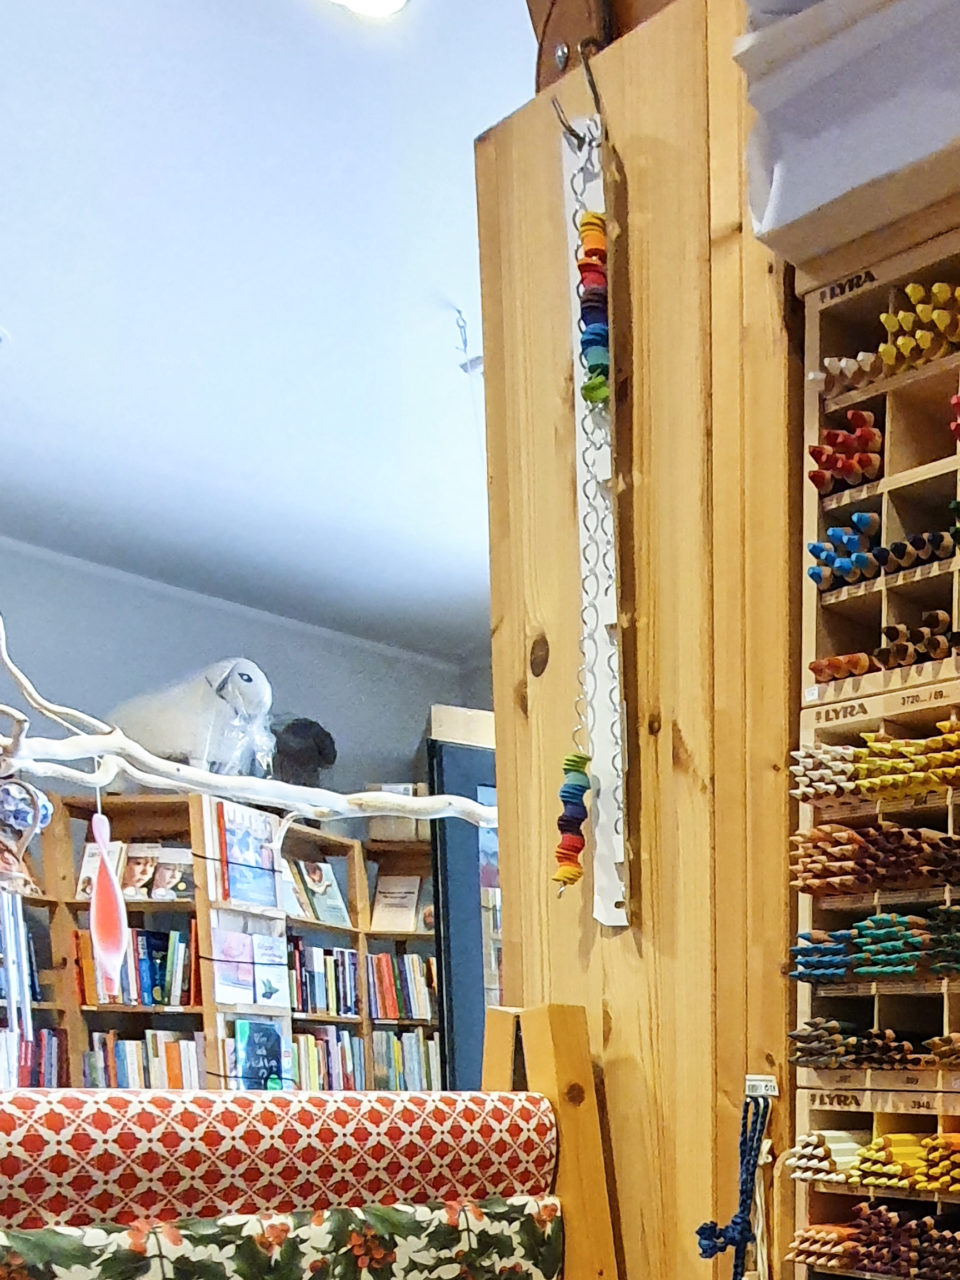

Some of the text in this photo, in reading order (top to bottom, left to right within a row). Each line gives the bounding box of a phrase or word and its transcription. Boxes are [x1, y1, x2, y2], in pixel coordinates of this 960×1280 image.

[829, 270, 878, 300] LYRA
[824, 702, 868, 722] LYRA
[820, 1093, 861, 1107] LYRA
